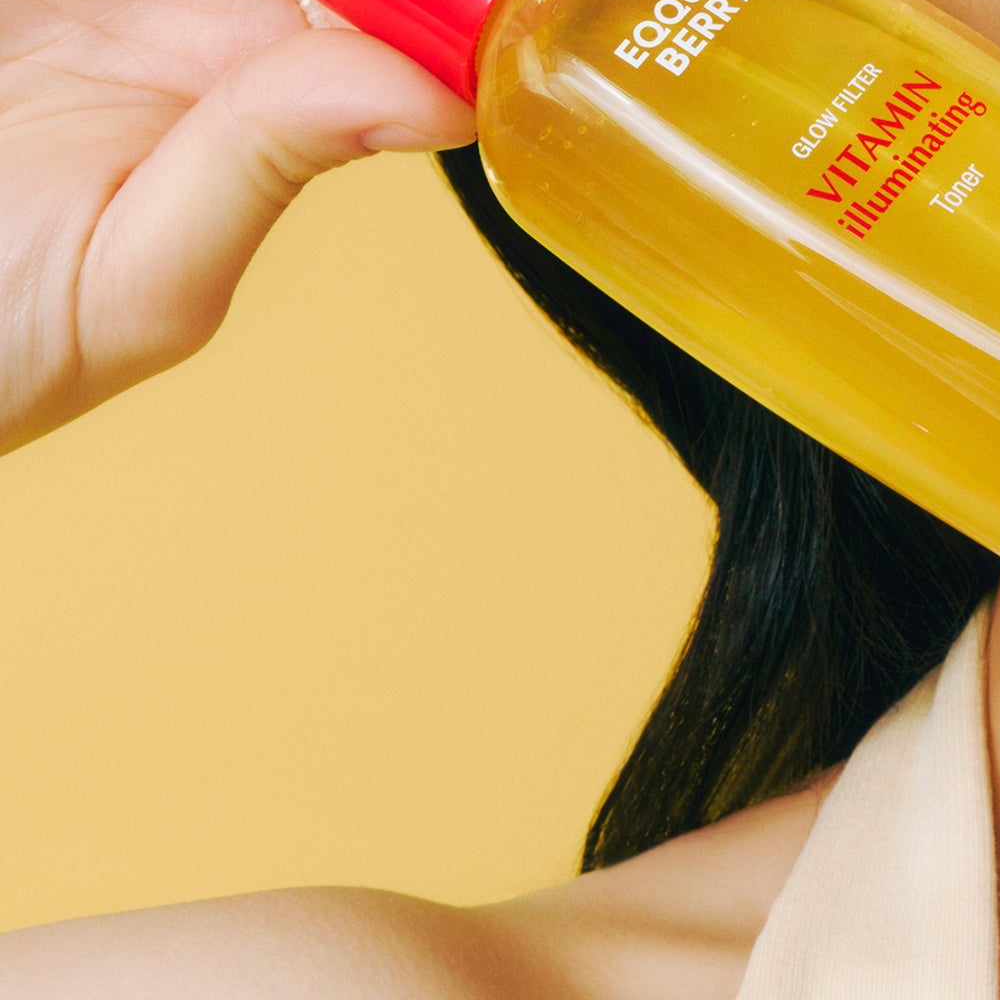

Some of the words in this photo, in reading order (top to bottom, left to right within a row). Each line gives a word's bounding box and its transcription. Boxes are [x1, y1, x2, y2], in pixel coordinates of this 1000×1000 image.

[791, 108, 839, 159] GLOW
[832, 62, 883, 113] FILTER
[806, 69, 942, 205] VITAMIN
[838, 92, 987, 240] illuminating
[929, 163, 984, 214] Toner
